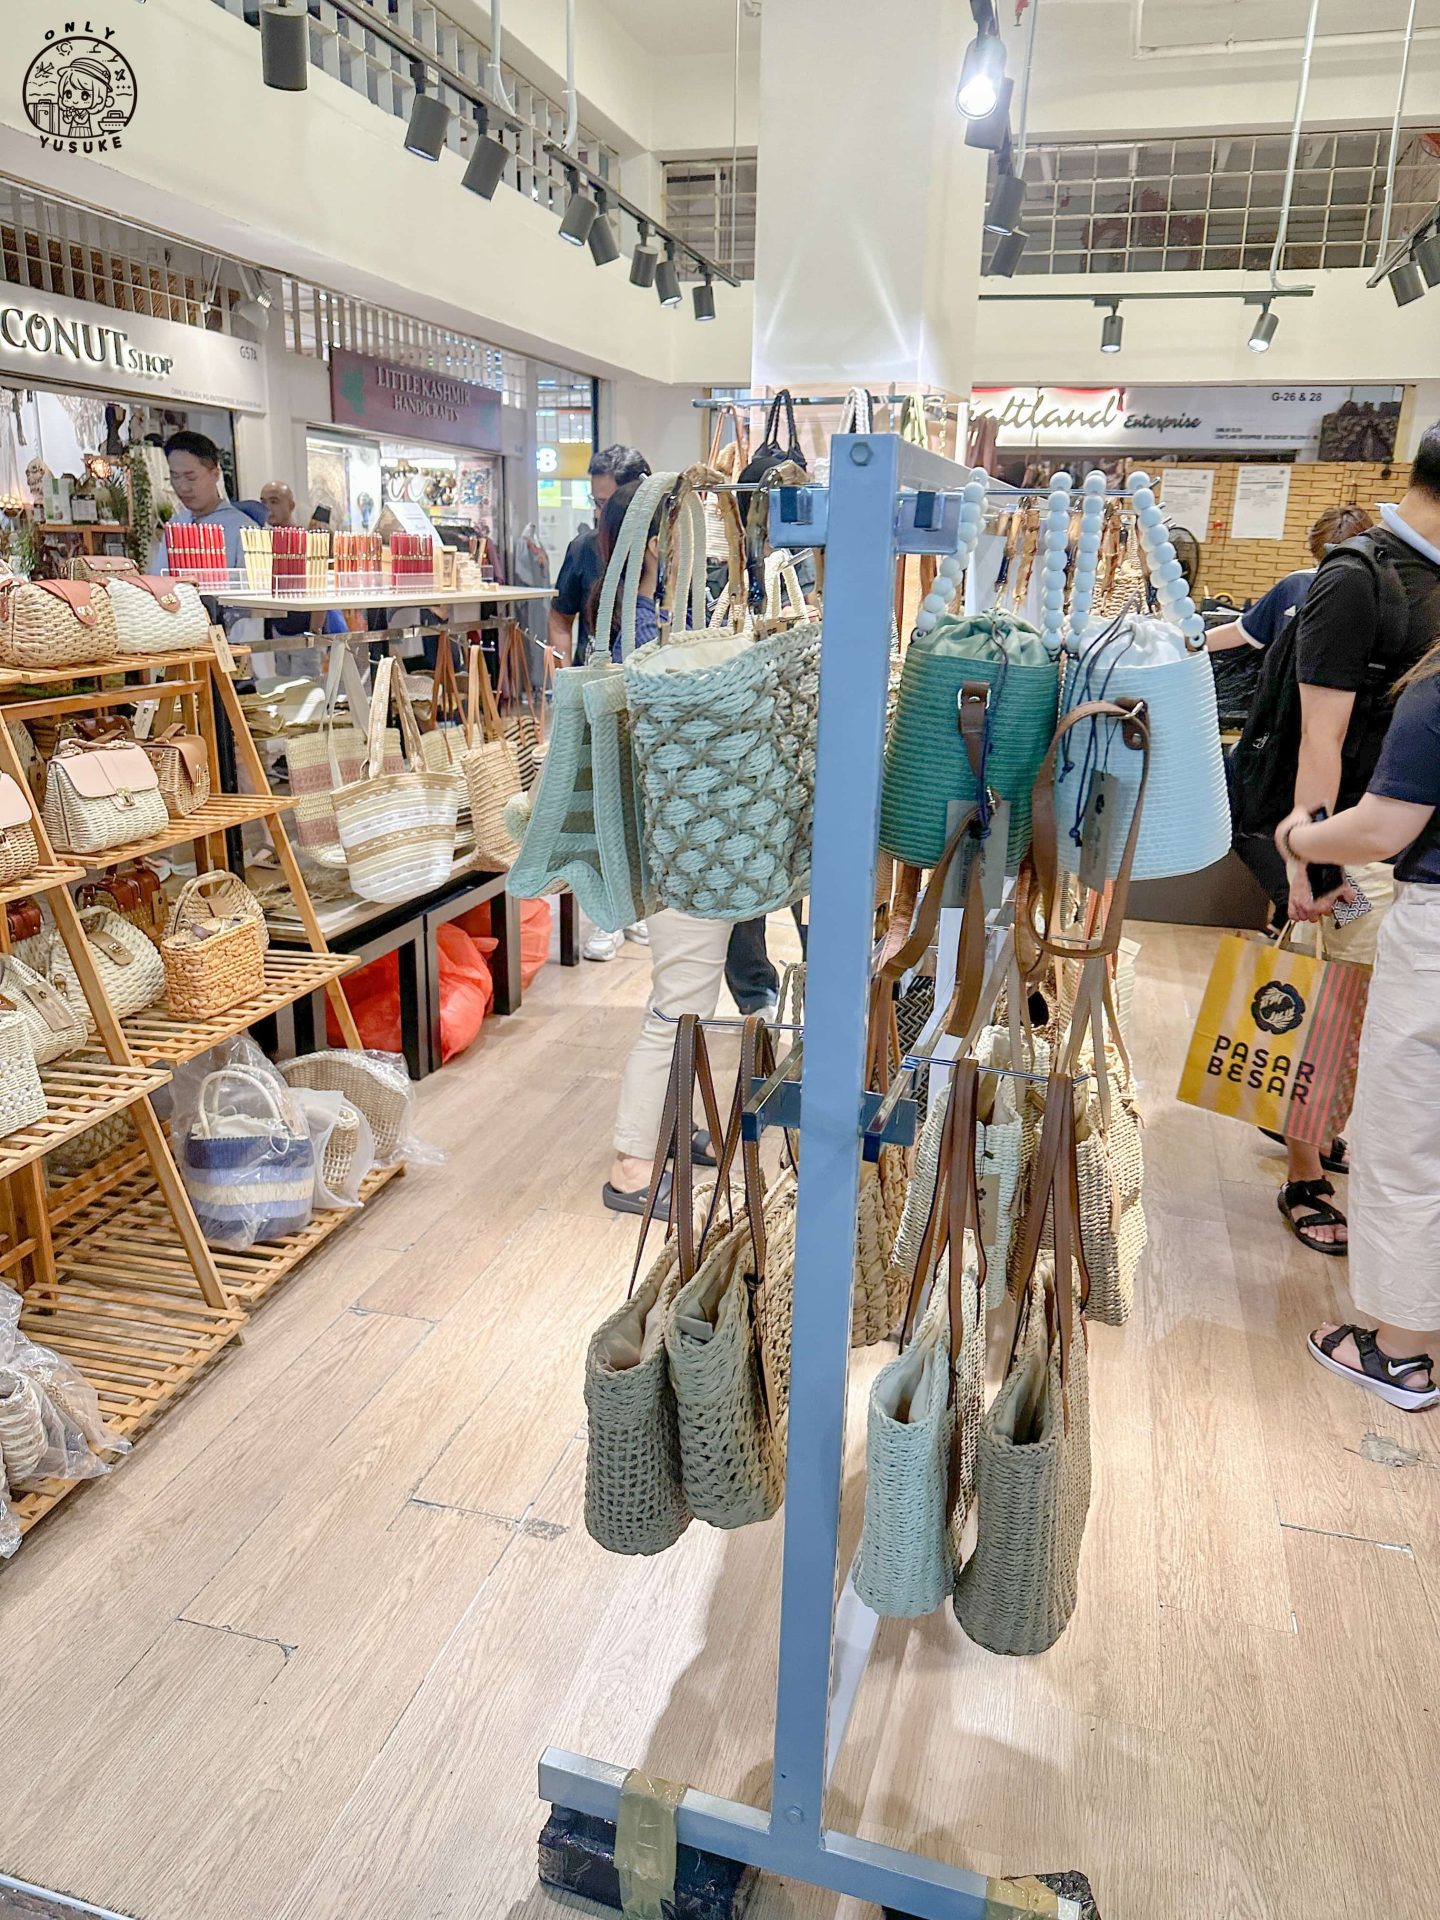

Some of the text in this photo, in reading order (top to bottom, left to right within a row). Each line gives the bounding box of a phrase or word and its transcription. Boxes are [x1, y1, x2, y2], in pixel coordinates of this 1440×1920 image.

[1, 308, 174, 375] CONUT SHOP
[376, 366, 471, 407] LITTLE KASHMIR
[1271, 393, 1322, 402] G-26 & 28
[393, 394, 459, 422] HANDICRAFTS
[1123, 413, 1201, 433] Enterprise
[1213, 1034, 1315, 1084] PASAR
[1207, 1055, 1310, 1105] BESAR
